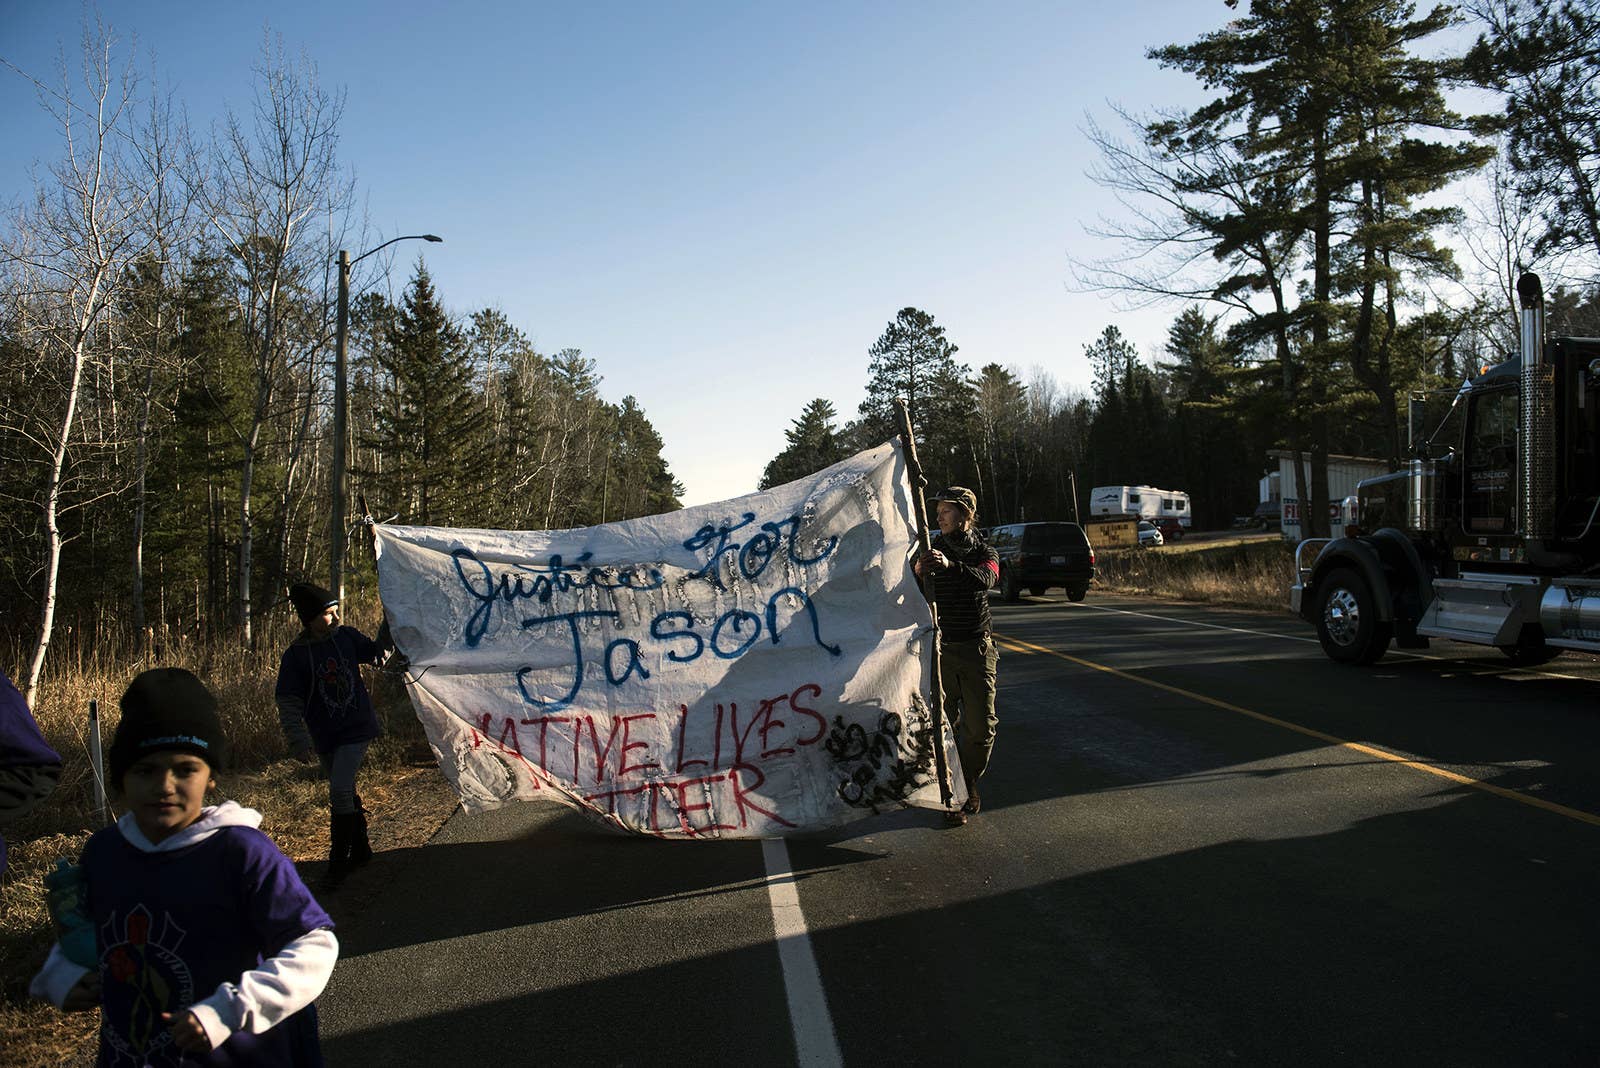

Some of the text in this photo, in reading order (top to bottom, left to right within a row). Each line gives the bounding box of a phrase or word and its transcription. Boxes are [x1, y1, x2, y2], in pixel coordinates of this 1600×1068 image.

[451, 548, 663, 648] Justice
[516, 586, 842, 708] Jason
[676, 683, 828, 774] LIVES
[583, 762, 798, 838] TTER
